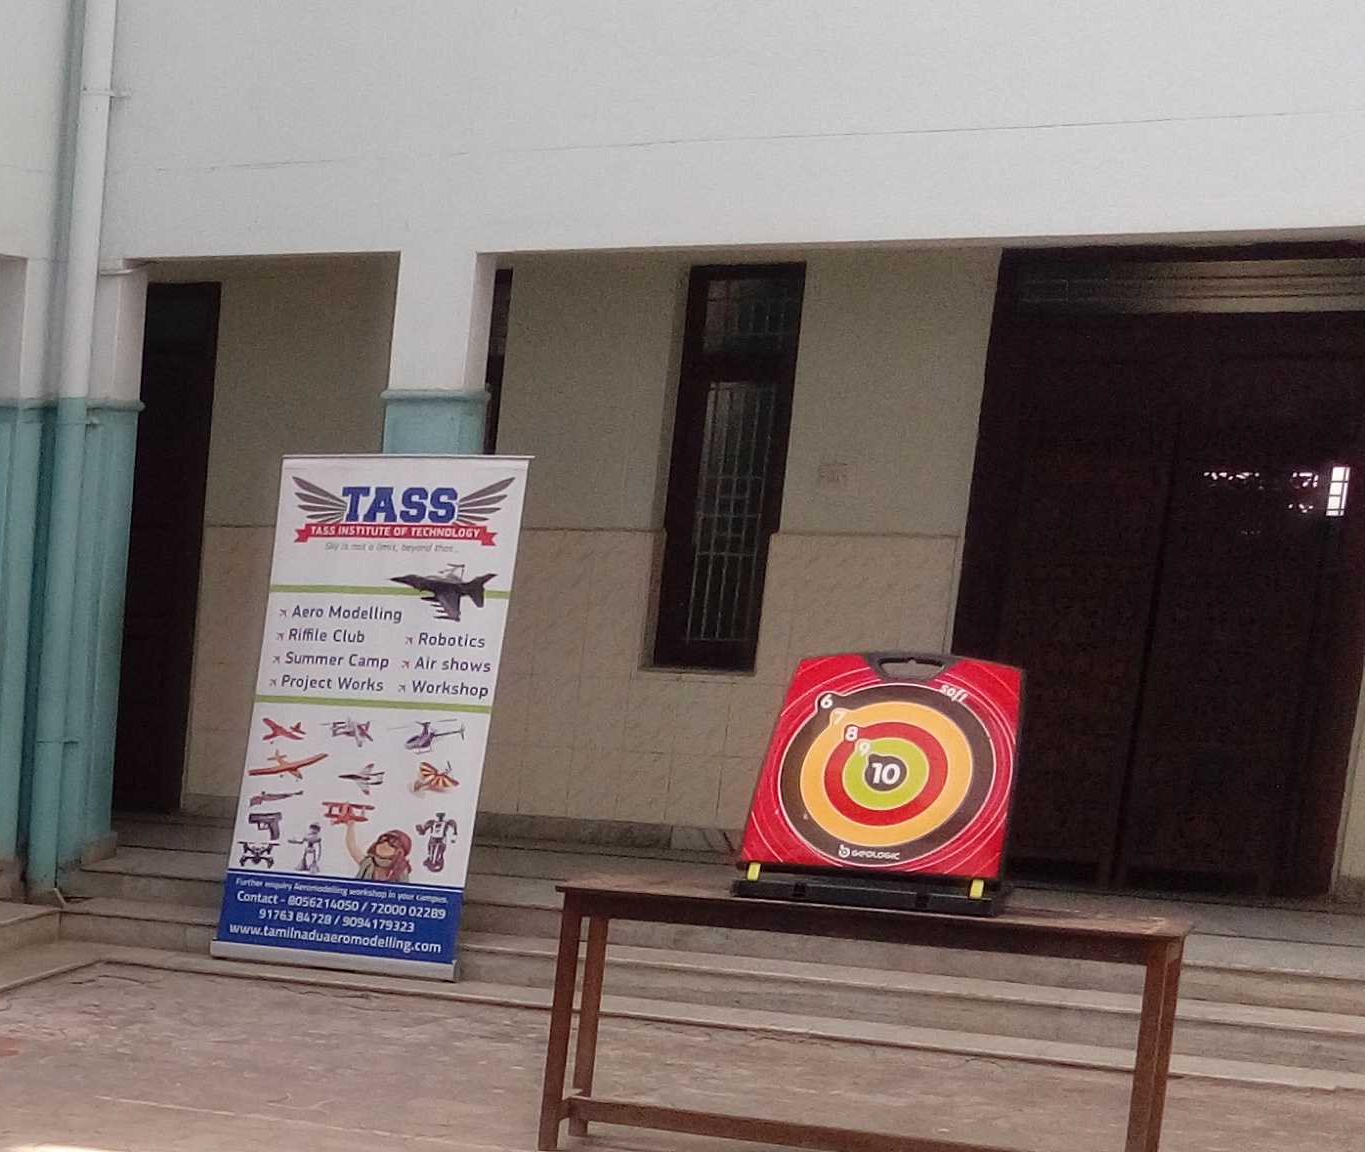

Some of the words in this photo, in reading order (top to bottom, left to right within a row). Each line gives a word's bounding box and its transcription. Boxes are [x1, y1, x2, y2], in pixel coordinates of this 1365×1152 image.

[342, 486, 458, 524] TASS
[310, 526, 335, 535] TASS
[338, 526, 391, 536] INSTITUTE
[393, 527, 407, 537] OF
[411, 527, 480, 538] TECHNOLOGY
[325, 542, 339, 552] Sky
[292, 606, 323, 619] Aero
[328, 606, 402, 624] Modelling
[333, 630, 365, 643] Club
[418, 633, 485, 649] Robotics
[285, 652, 343, 667] Summer
[348, 654, 389, 671] Camp
[415, 657, 437, 670] Air
[442, 658, 491, 673] shows
[282, 675, 332, 690] Project
[338, 677, 383, 692] Works
[412, 680, 488, 699] Workshop
[820, 694, 833, 708] 6
[939, 684, 968, 702] soft
[834, 711, 847, 724] 7
[846, 726, 858, 741] 8
[859, 742, 871, 756] 9
[872, 763, 901, 785] 10
[237, 891, 278, 905] Contact
[288, 896, 359, 912] 8056214050
[361, 902, 368, 912] /
[371, 903, 406, 918] 72000
[409, 905, 446, 920] 02289
[259, 909, 293, 923] 91763
[296, 911, 331, 926] 84728
[333, 914, 340, 927] /
[343, 916, 415, 933] 9094179323
[229, 924, 441, 954] www.tamilnaduaeromodelling.com
